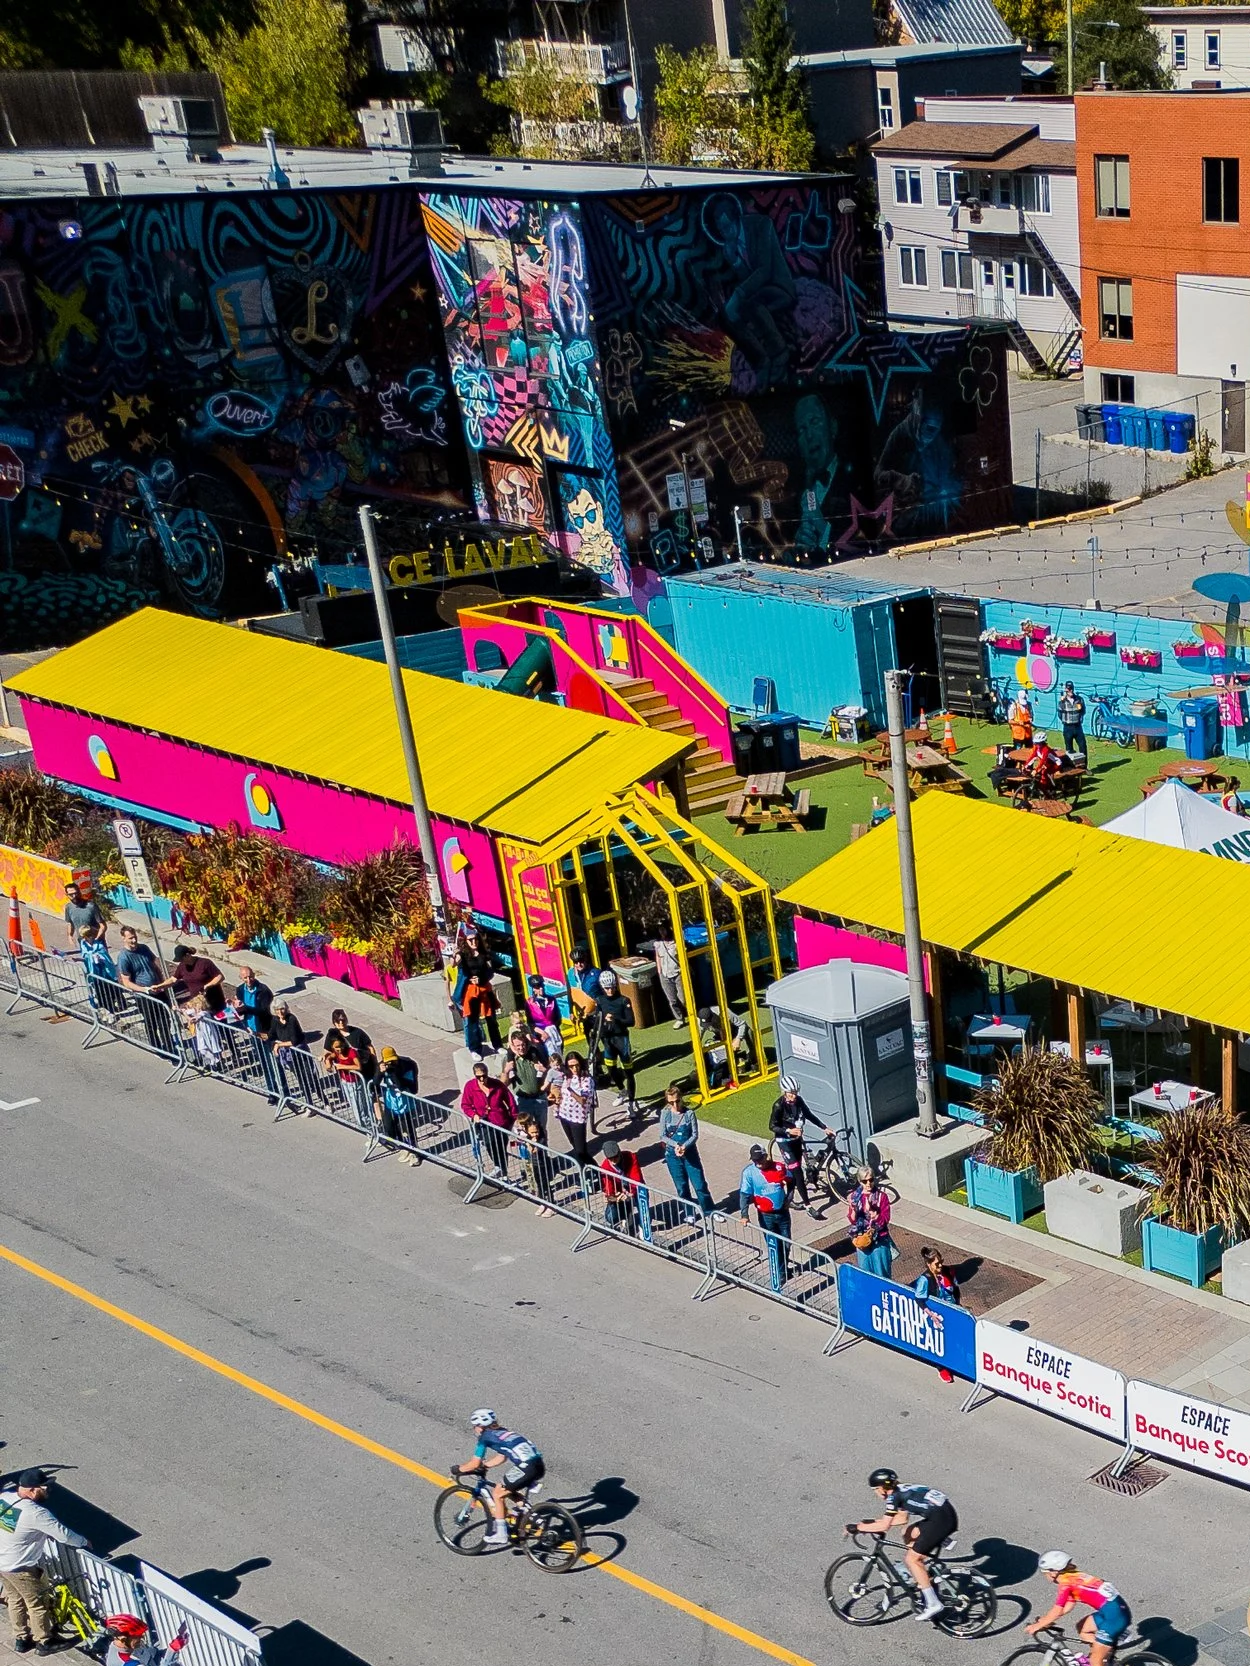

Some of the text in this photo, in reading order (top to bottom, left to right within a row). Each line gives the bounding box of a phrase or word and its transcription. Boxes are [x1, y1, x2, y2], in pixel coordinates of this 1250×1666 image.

[210, 395, 270, 427] Ouvert
[444, 534, 547, 578] LAVAL
[881, 1291, 890, 1302] LE
[871, 1304, 945, 1357] GATINEAU
[1026, 1346, 1073, 1379] ESPACE
[983, 1352, 1112, 1419] Banque Scotia
[1135, 1413, 1210, 1455] Banque
[1181, 1405, 1231, 1437] ESPACE
